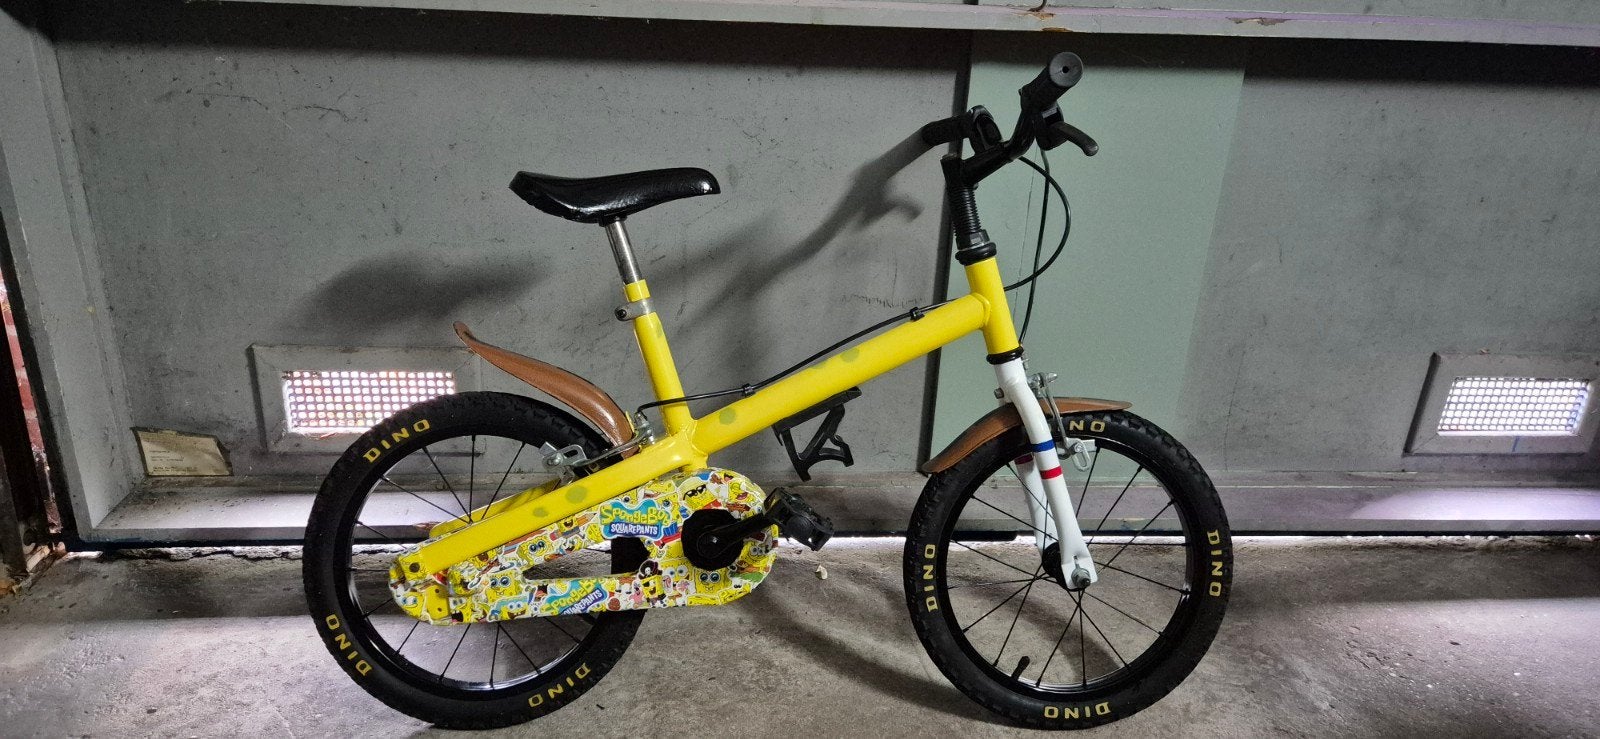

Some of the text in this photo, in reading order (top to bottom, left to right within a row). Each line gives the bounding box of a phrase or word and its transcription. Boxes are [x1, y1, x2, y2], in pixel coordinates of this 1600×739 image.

[363, 419, 430, 463] DINO
[1056, 419, 1106, 433] NO
[600, 504, 670, 526] SpongeBob
[611, 523, 658, 535] SQUAREPANTS
[923, 544, 938, 613] DINO
[1206, 529, 1223, 597] DINO
[326, 614, 372, 676] DINO
[528, 662, 592, 707] DINO
[1044, 701, 1111, 719] DINO
